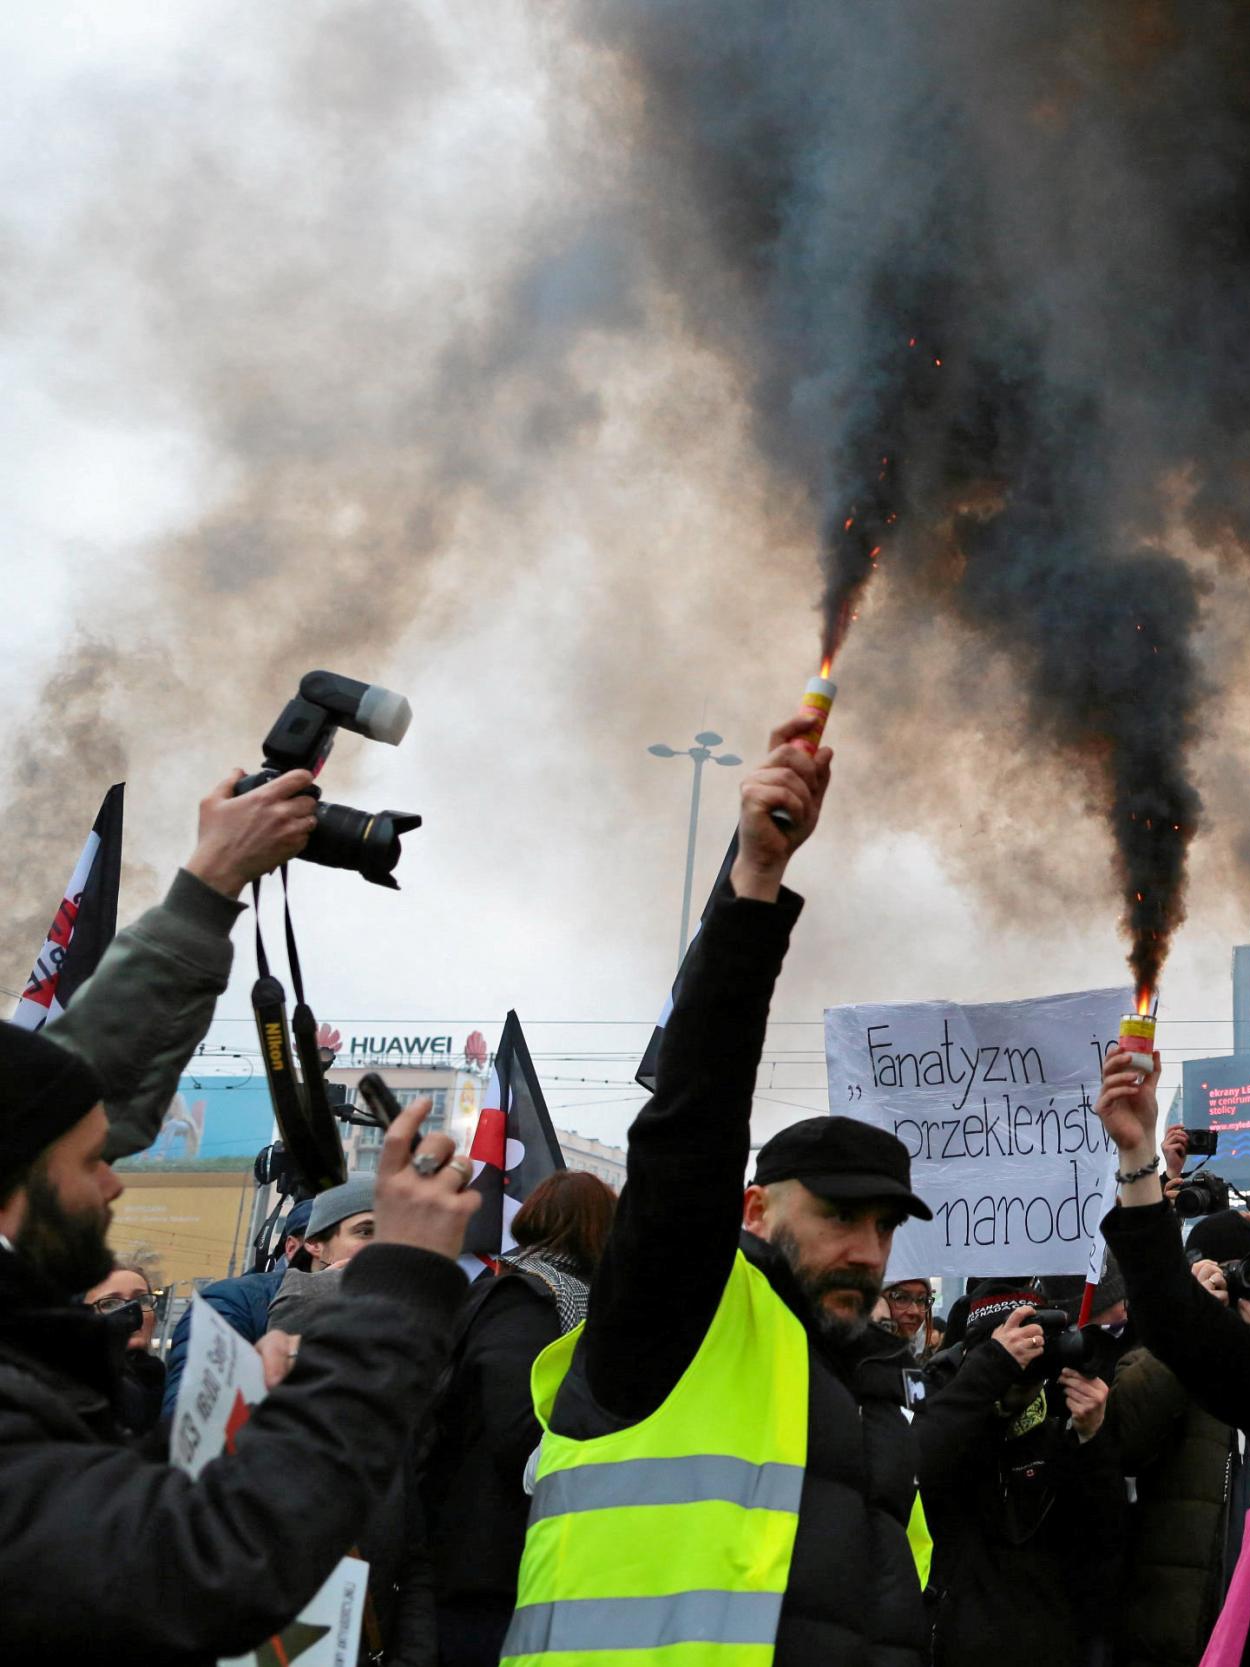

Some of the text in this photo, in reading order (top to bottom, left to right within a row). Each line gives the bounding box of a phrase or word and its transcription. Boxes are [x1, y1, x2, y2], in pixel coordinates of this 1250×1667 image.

[265, 1022, 284, 1071] Nikon
[350, 1037, 453, 1054] HUAWEI
[1209, 1088, 1240, 1098] ekrany
[1209, 1099, 1217, 1107] w
[1209, 1106, 1236, 1115] stolicy
